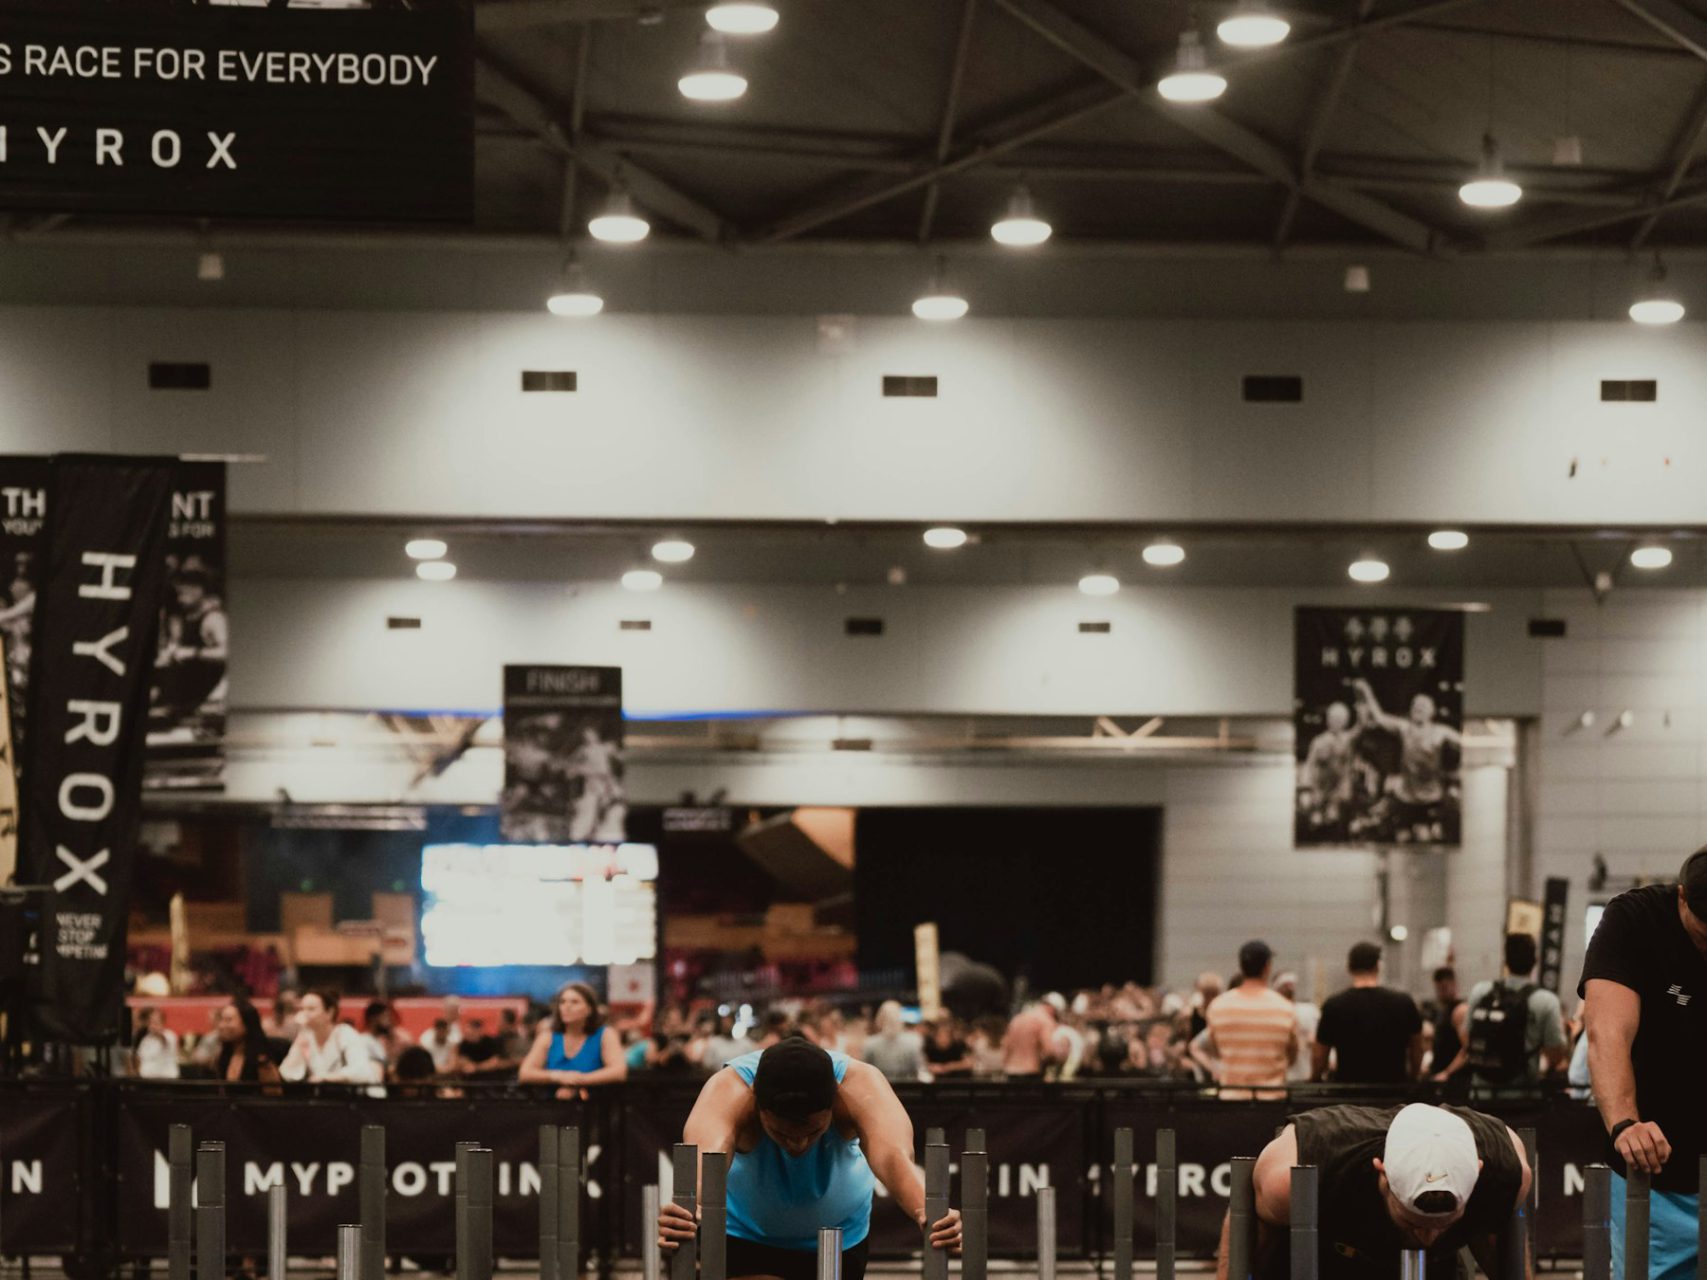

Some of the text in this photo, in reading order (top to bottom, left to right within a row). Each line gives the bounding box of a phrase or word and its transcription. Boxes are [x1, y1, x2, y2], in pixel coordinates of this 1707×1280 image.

[25, 45, 121, 77] RACE
[134, 48, 205, 80] FOR
[218, 50, 438, 86] EVERYBODY
[0, 125, 237, 169] YROX
[1321, 646, 1436, 668] HYROX
[53, 552, 136, 895] HYROX
[244, 1161, 541, 1196] MYPOTIN
